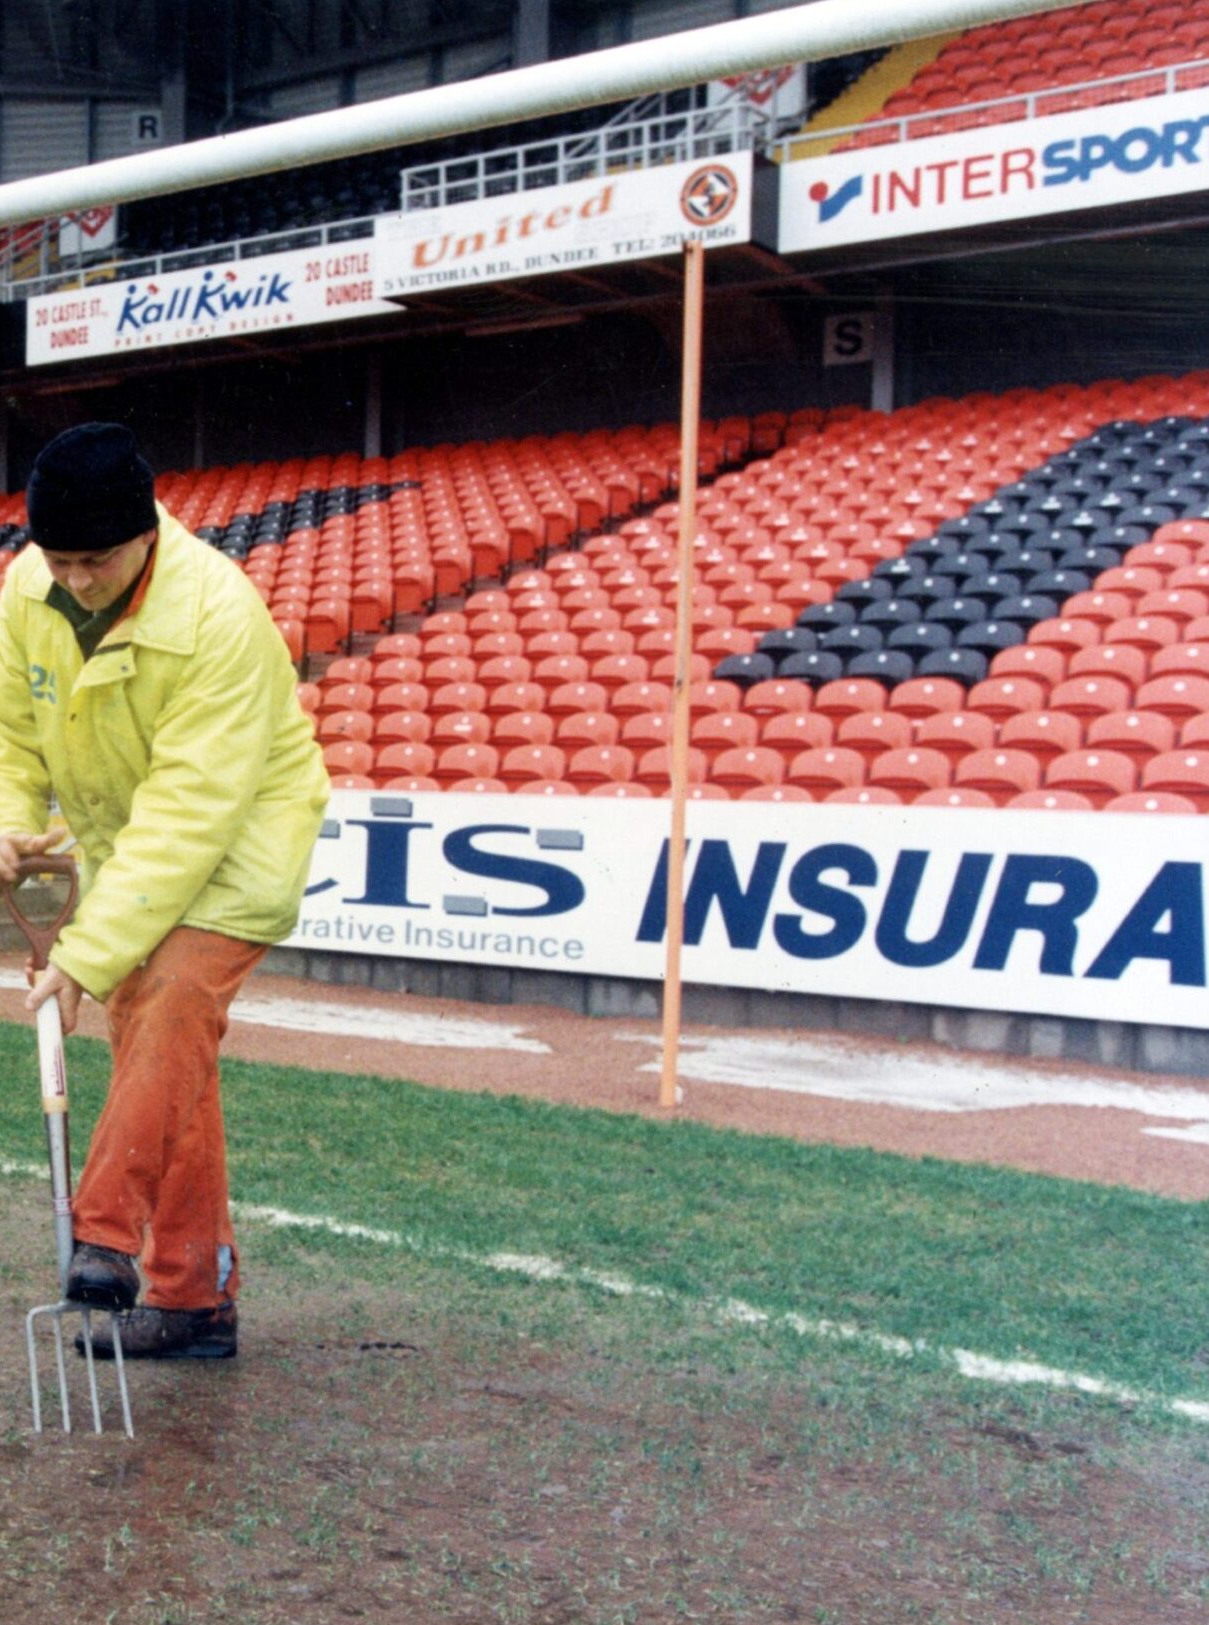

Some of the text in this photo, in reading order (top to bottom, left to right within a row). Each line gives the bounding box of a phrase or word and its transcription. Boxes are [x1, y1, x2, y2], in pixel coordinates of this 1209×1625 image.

[139, 115, 158, 138] R
[411, 181, 616, 269] United
[305, 253, 369, 282] 20 CASTLE
[397, 265, 480, 288] VICTORIA
[525, 247, 598, 270] DUNDEE
[326, 280, 374, 306] DUNDEE
[52, 301, 87, 324] CASTLE
[50, 326, 89, 348] DUNDEE
[834, 320, 863, 356] S
[291, 916, 584, 960] rative Insurance
